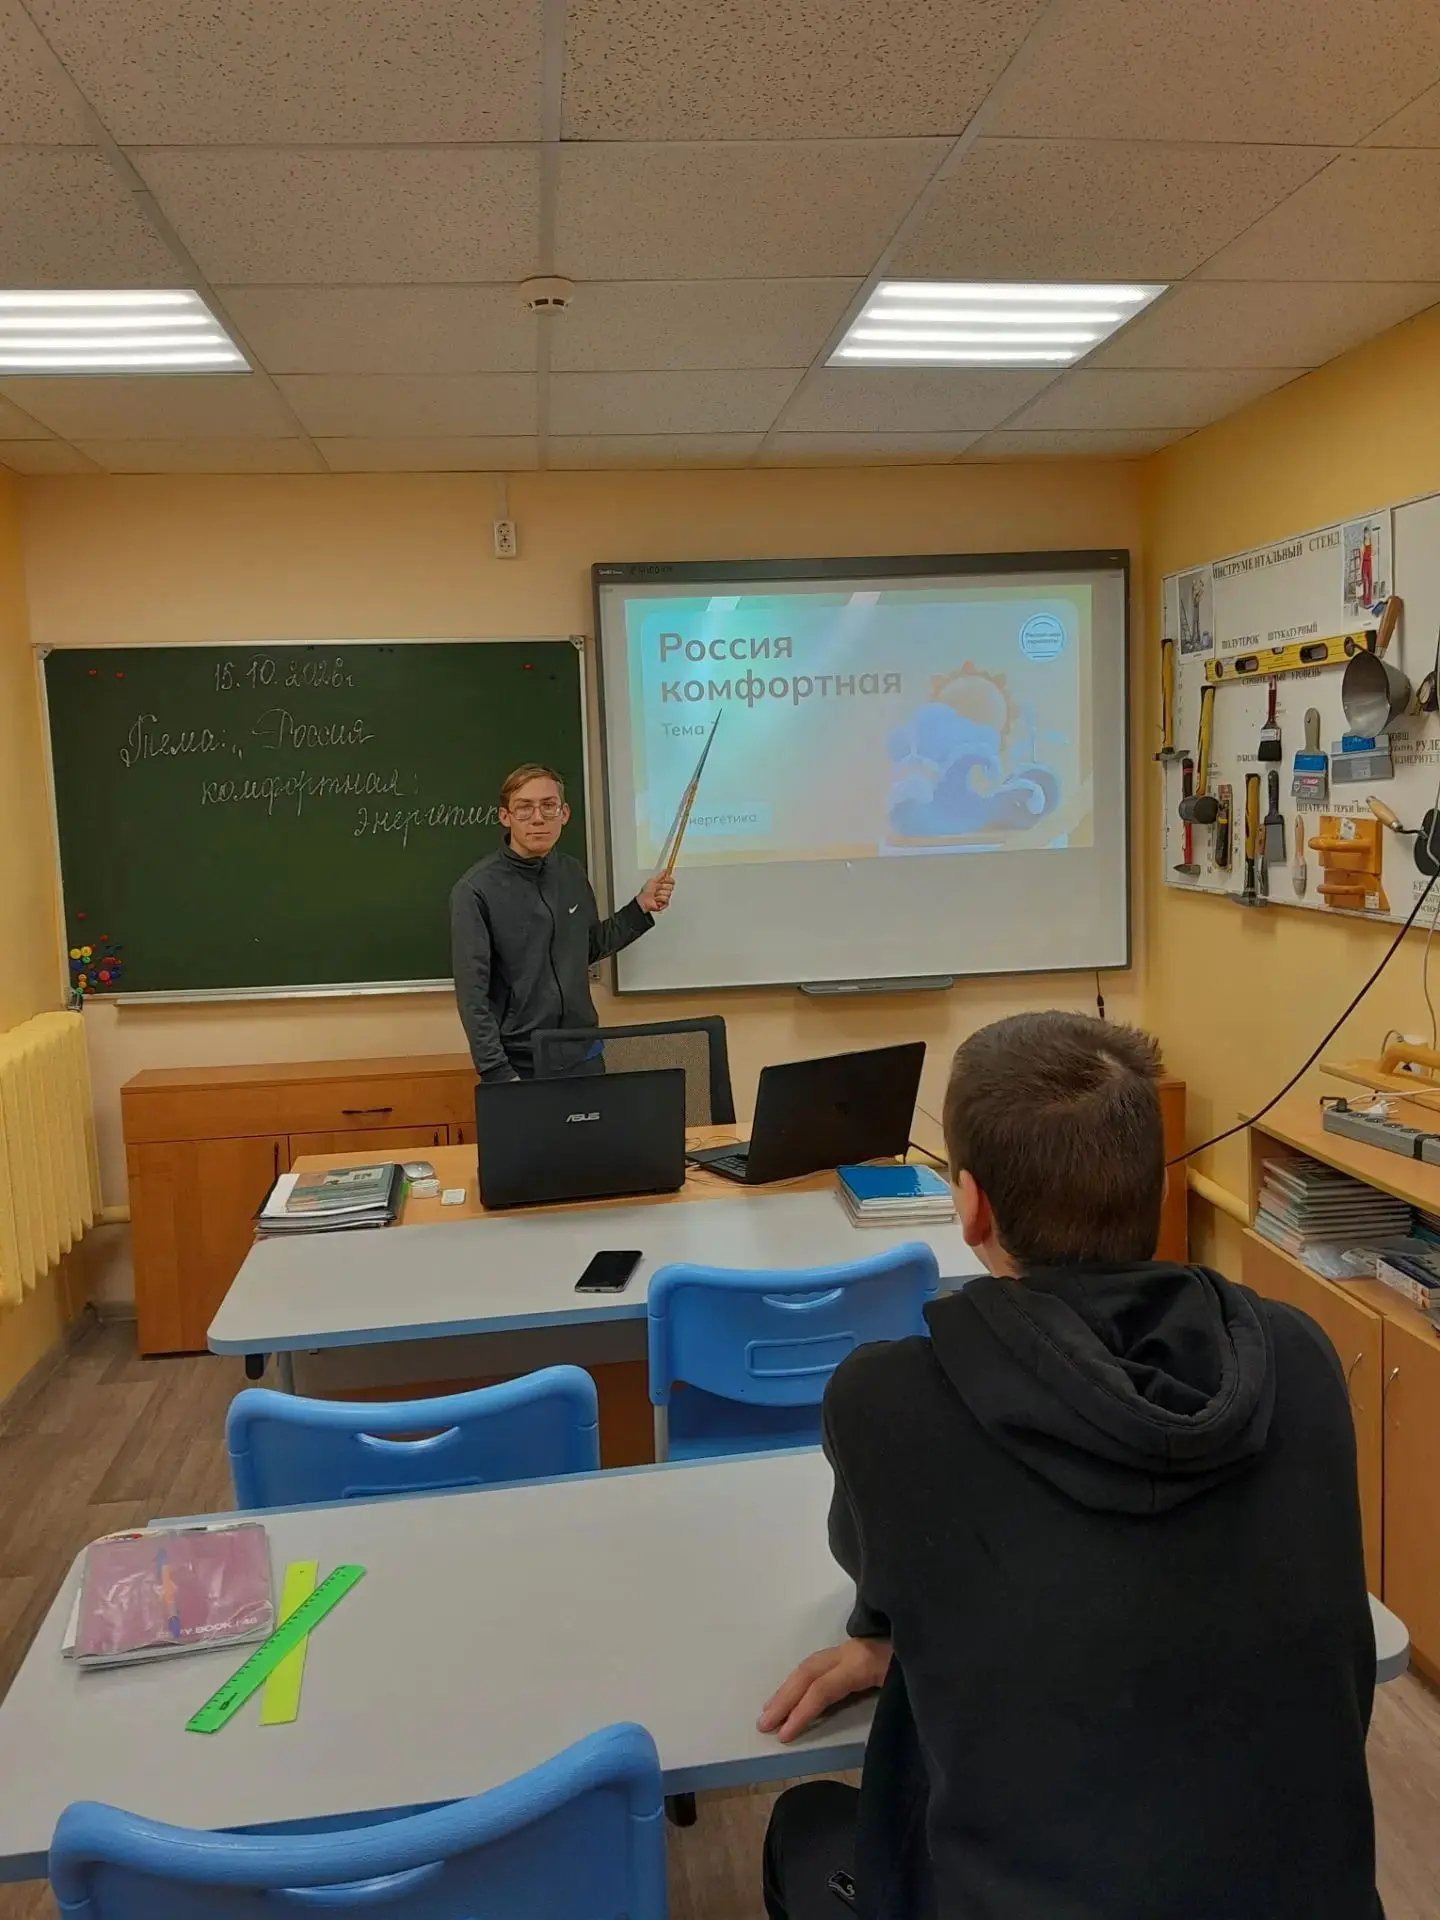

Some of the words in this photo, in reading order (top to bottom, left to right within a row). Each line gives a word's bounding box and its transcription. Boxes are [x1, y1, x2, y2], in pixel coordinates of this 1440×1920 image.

[1212, 541, 1303, 579] ИНСТРУМЕНТАЛЬНЫЙ
[1308, 531, 1340, 552] СТЕНД
[1267, 622, 1318, 641] ШТУКАТУРНЫЙ
[659, 632, 792, 662] Россия
[661, 668, 902, 708] комфортная
[661, 722, 705, 737] Тема
[682, 812, 757, 828] нергетика
[566, 1112, 600, 1123] ASUS
[195, 1622, 232, 1634] BOOK
